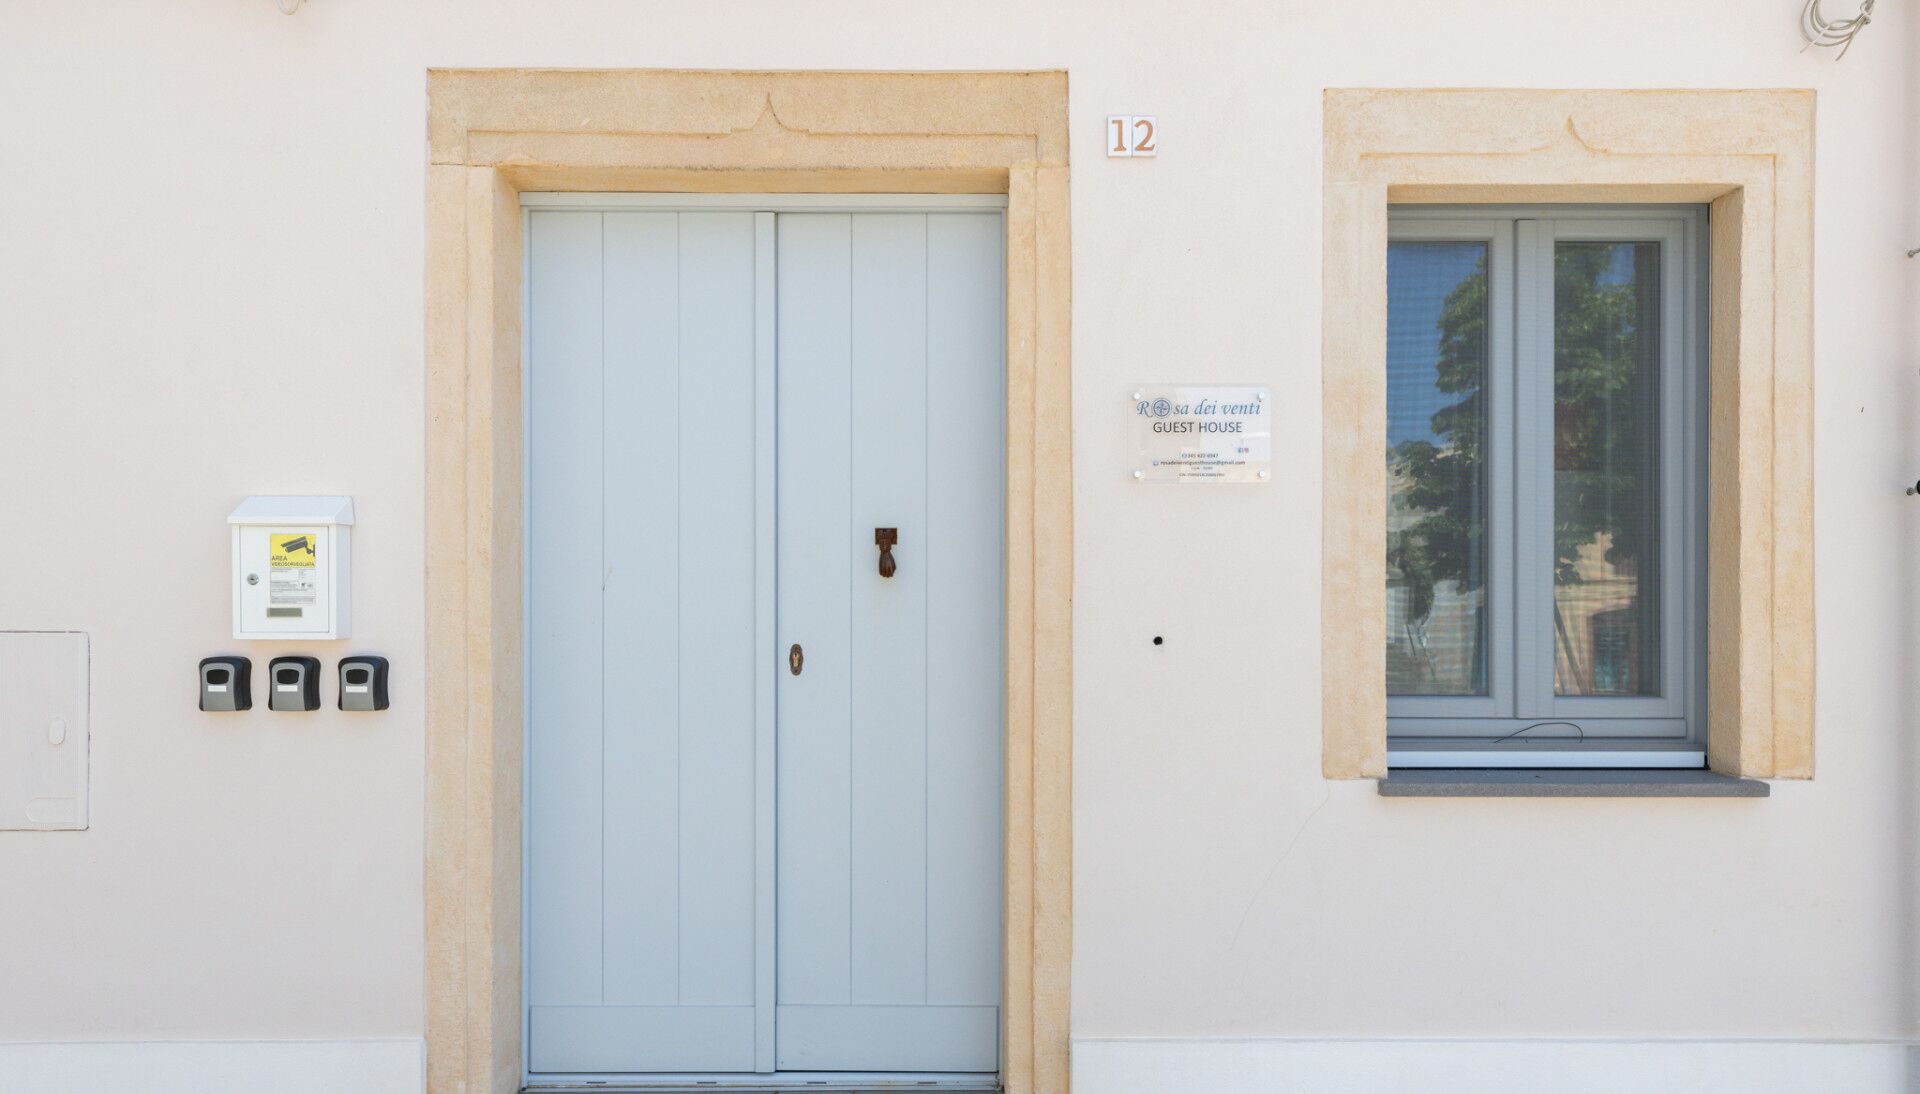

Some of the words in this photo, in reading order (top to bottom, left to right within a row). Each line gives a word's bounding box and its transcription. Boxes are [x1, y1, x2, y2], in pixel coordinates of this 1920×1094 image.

[1111, 119, 1156, 152] 12
[1194, 398, 1218, 415] dei
[1220, 399, 1262, 415] venti
[1153, 421, 1195, 433] GUEST
[1198, 421, 1243, 433] HOUSE
